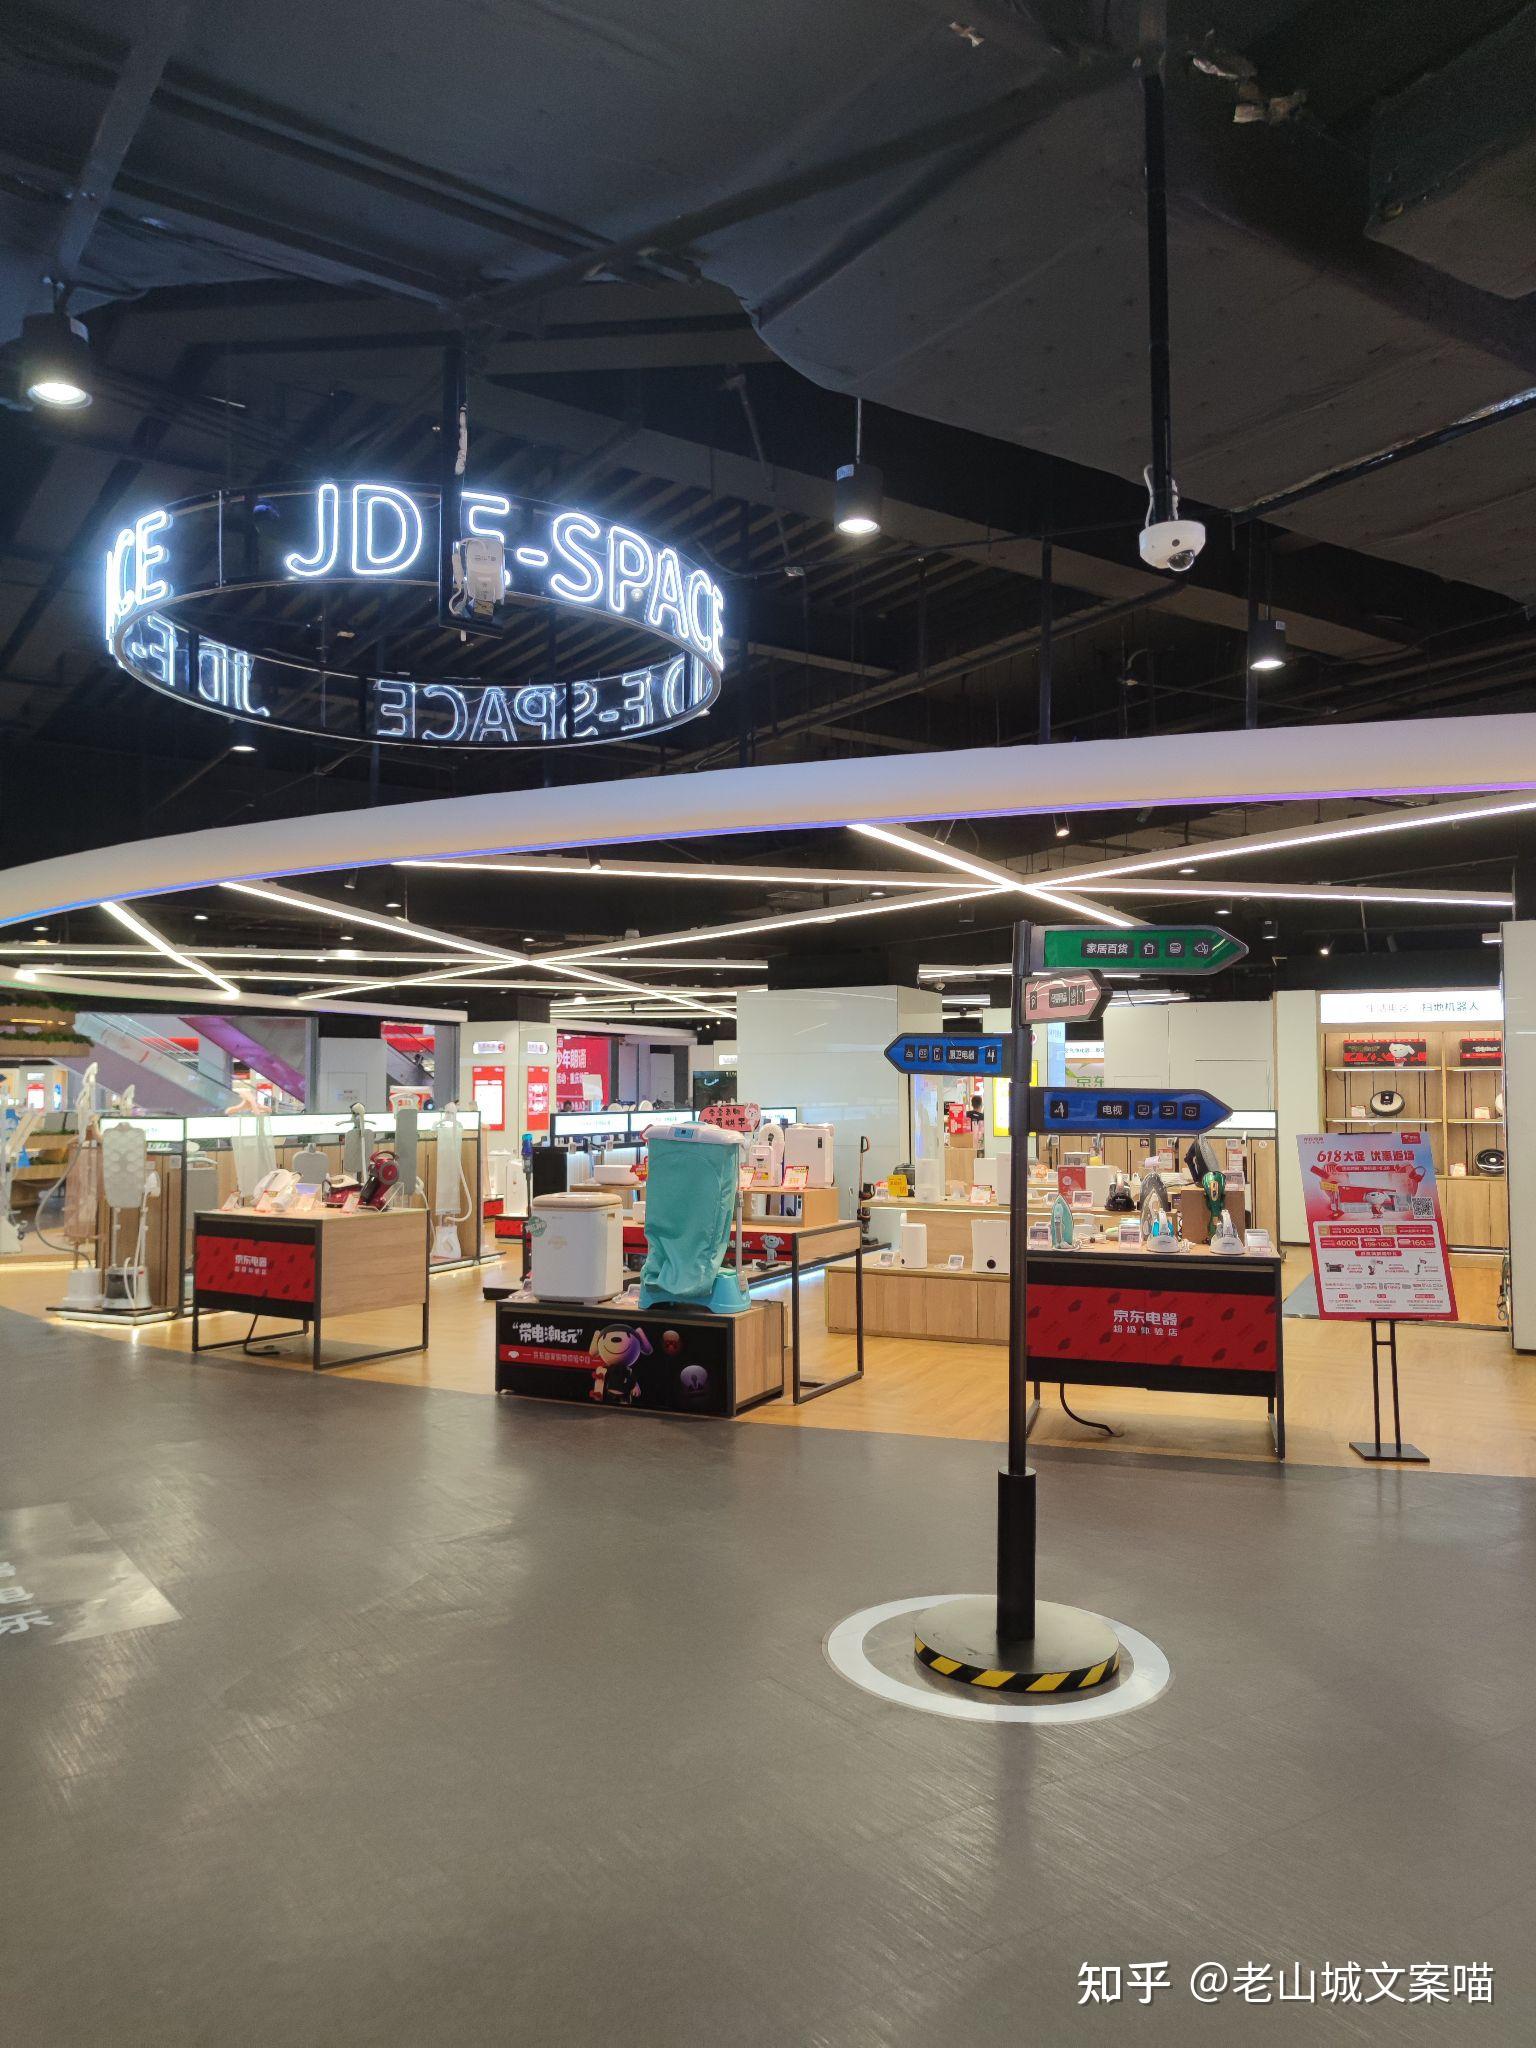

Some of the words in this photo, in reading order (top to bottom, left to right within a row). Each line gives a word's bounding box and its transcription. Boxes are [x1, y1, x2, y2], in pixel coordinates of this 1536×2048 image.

[284, 482, 424, 578] JD
[1086, 942, 1129, 956] 家居百货
[1102, 1104, 1123, 1116] 电视
[1113, 1309, 1178, 1326] 京东电器
